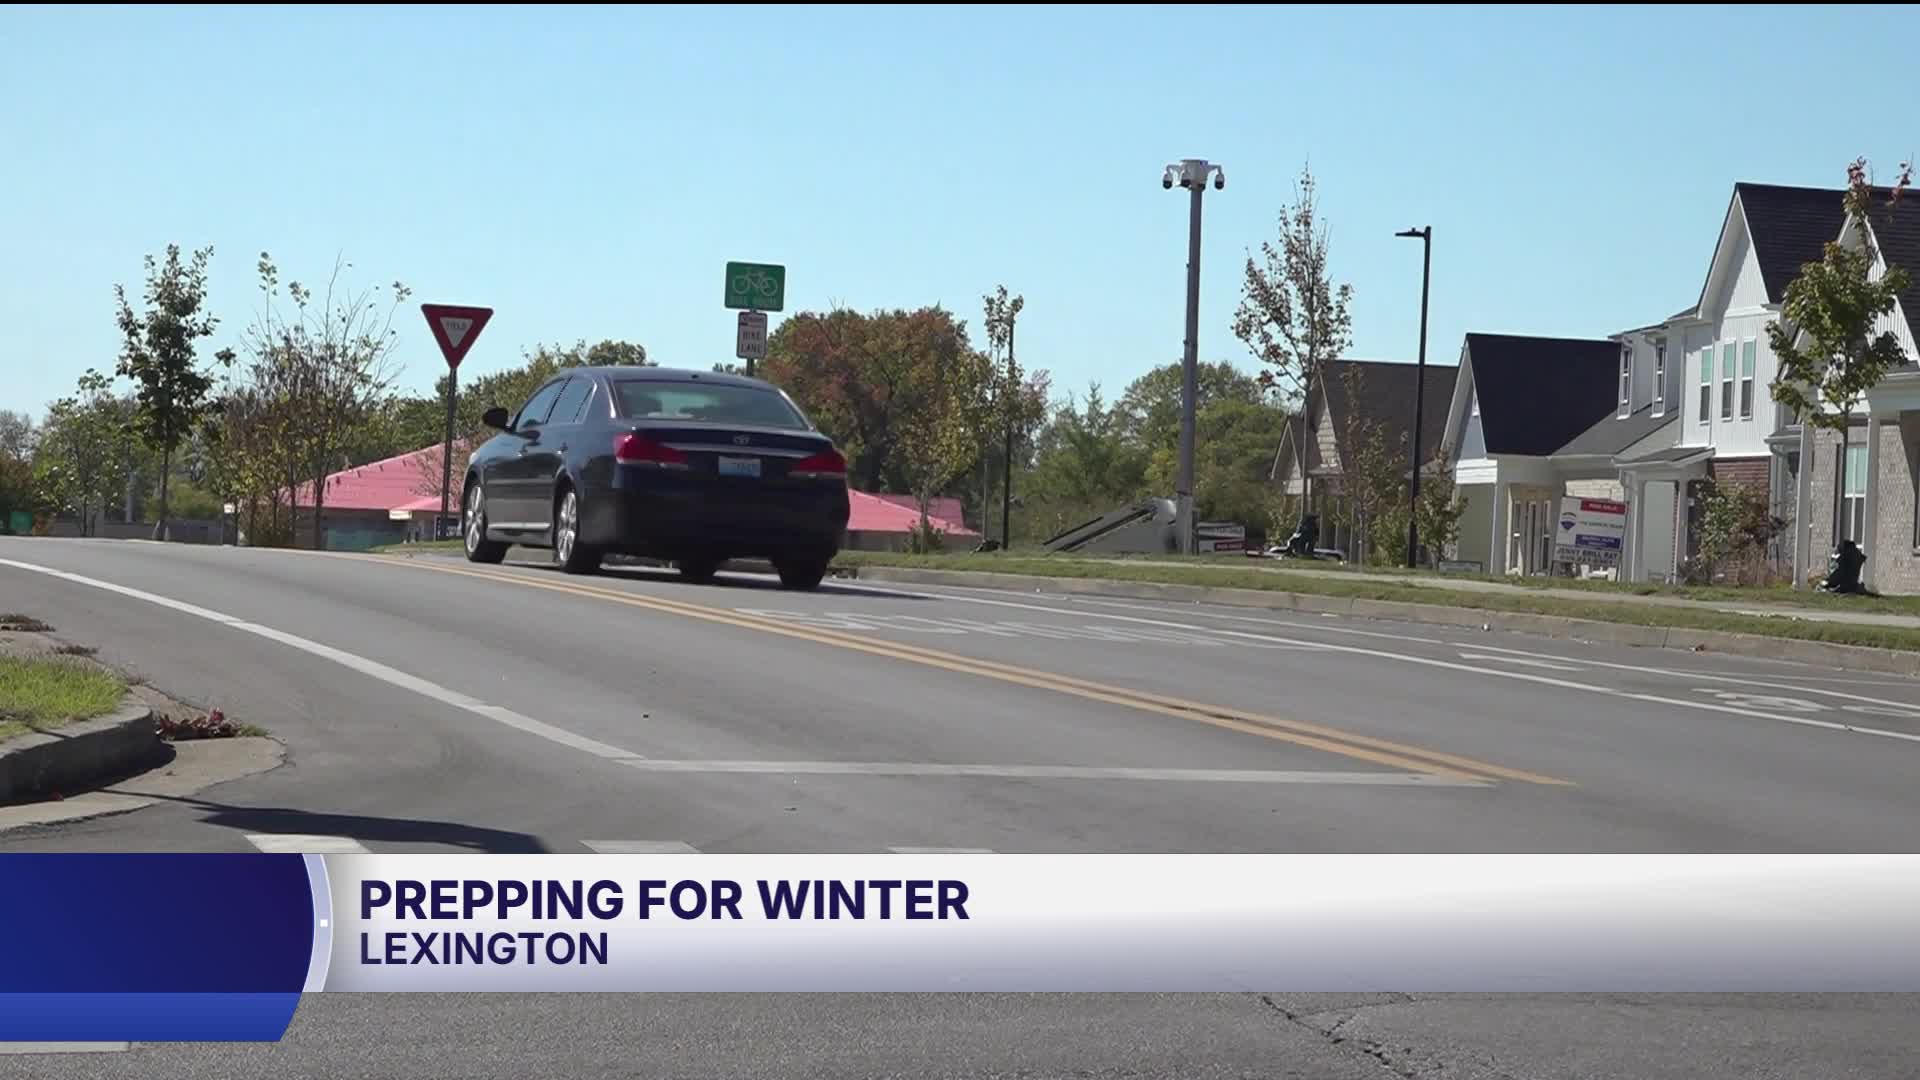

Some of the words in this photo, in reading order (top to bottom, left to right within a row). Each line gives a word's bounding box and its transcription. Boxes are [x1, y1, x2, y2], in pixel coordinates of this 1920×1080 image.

[743, 331, 761, 340] BIKE
[741, 343, 761, 353] LANE
[735, 608, 1325, 650] SCHOOL
